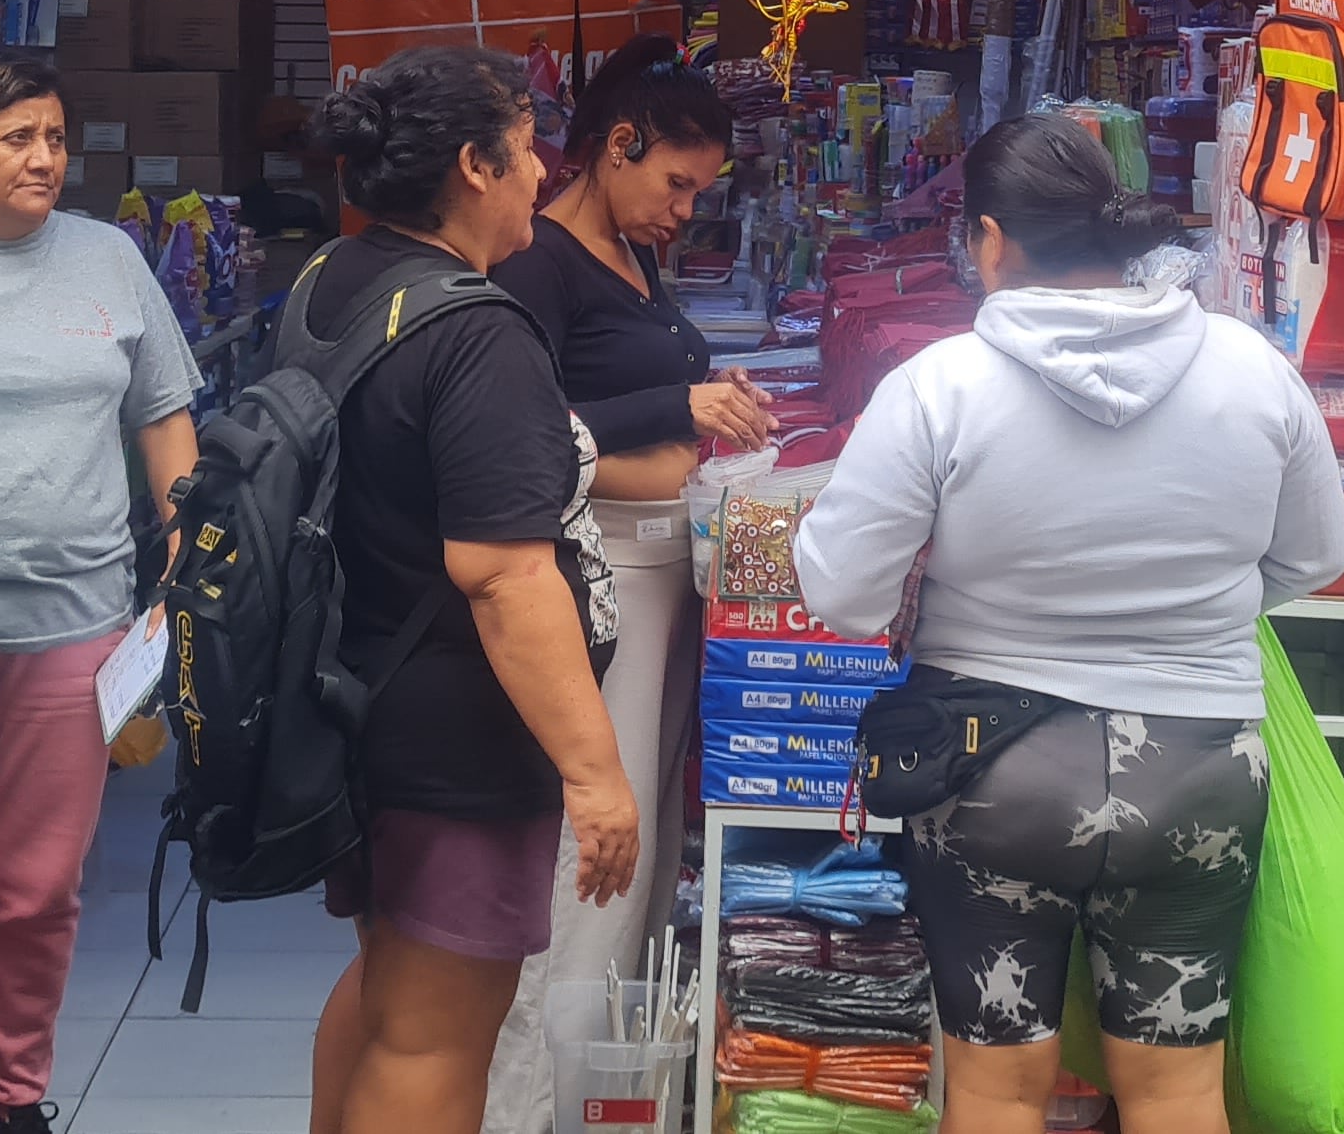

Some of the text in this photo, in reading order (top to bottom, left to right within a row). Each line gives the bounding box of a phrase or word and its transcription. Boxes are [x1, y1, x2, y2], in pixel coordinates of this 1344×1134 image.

[1241, 254, 1285, 278] BOTIIN
[750, 653, 765, 664] A4
[805, 651, 899, 673] MILLENIUM
[745, 694, 761, 704] A4
[800, 691, 867, 710] MILLENI
[733, 737, 748, 748] A4
[787, 734, 854, 753] MILLENI
[731, 779, 748, 790] A4
[786, 776, 848, 794] MILLEN
